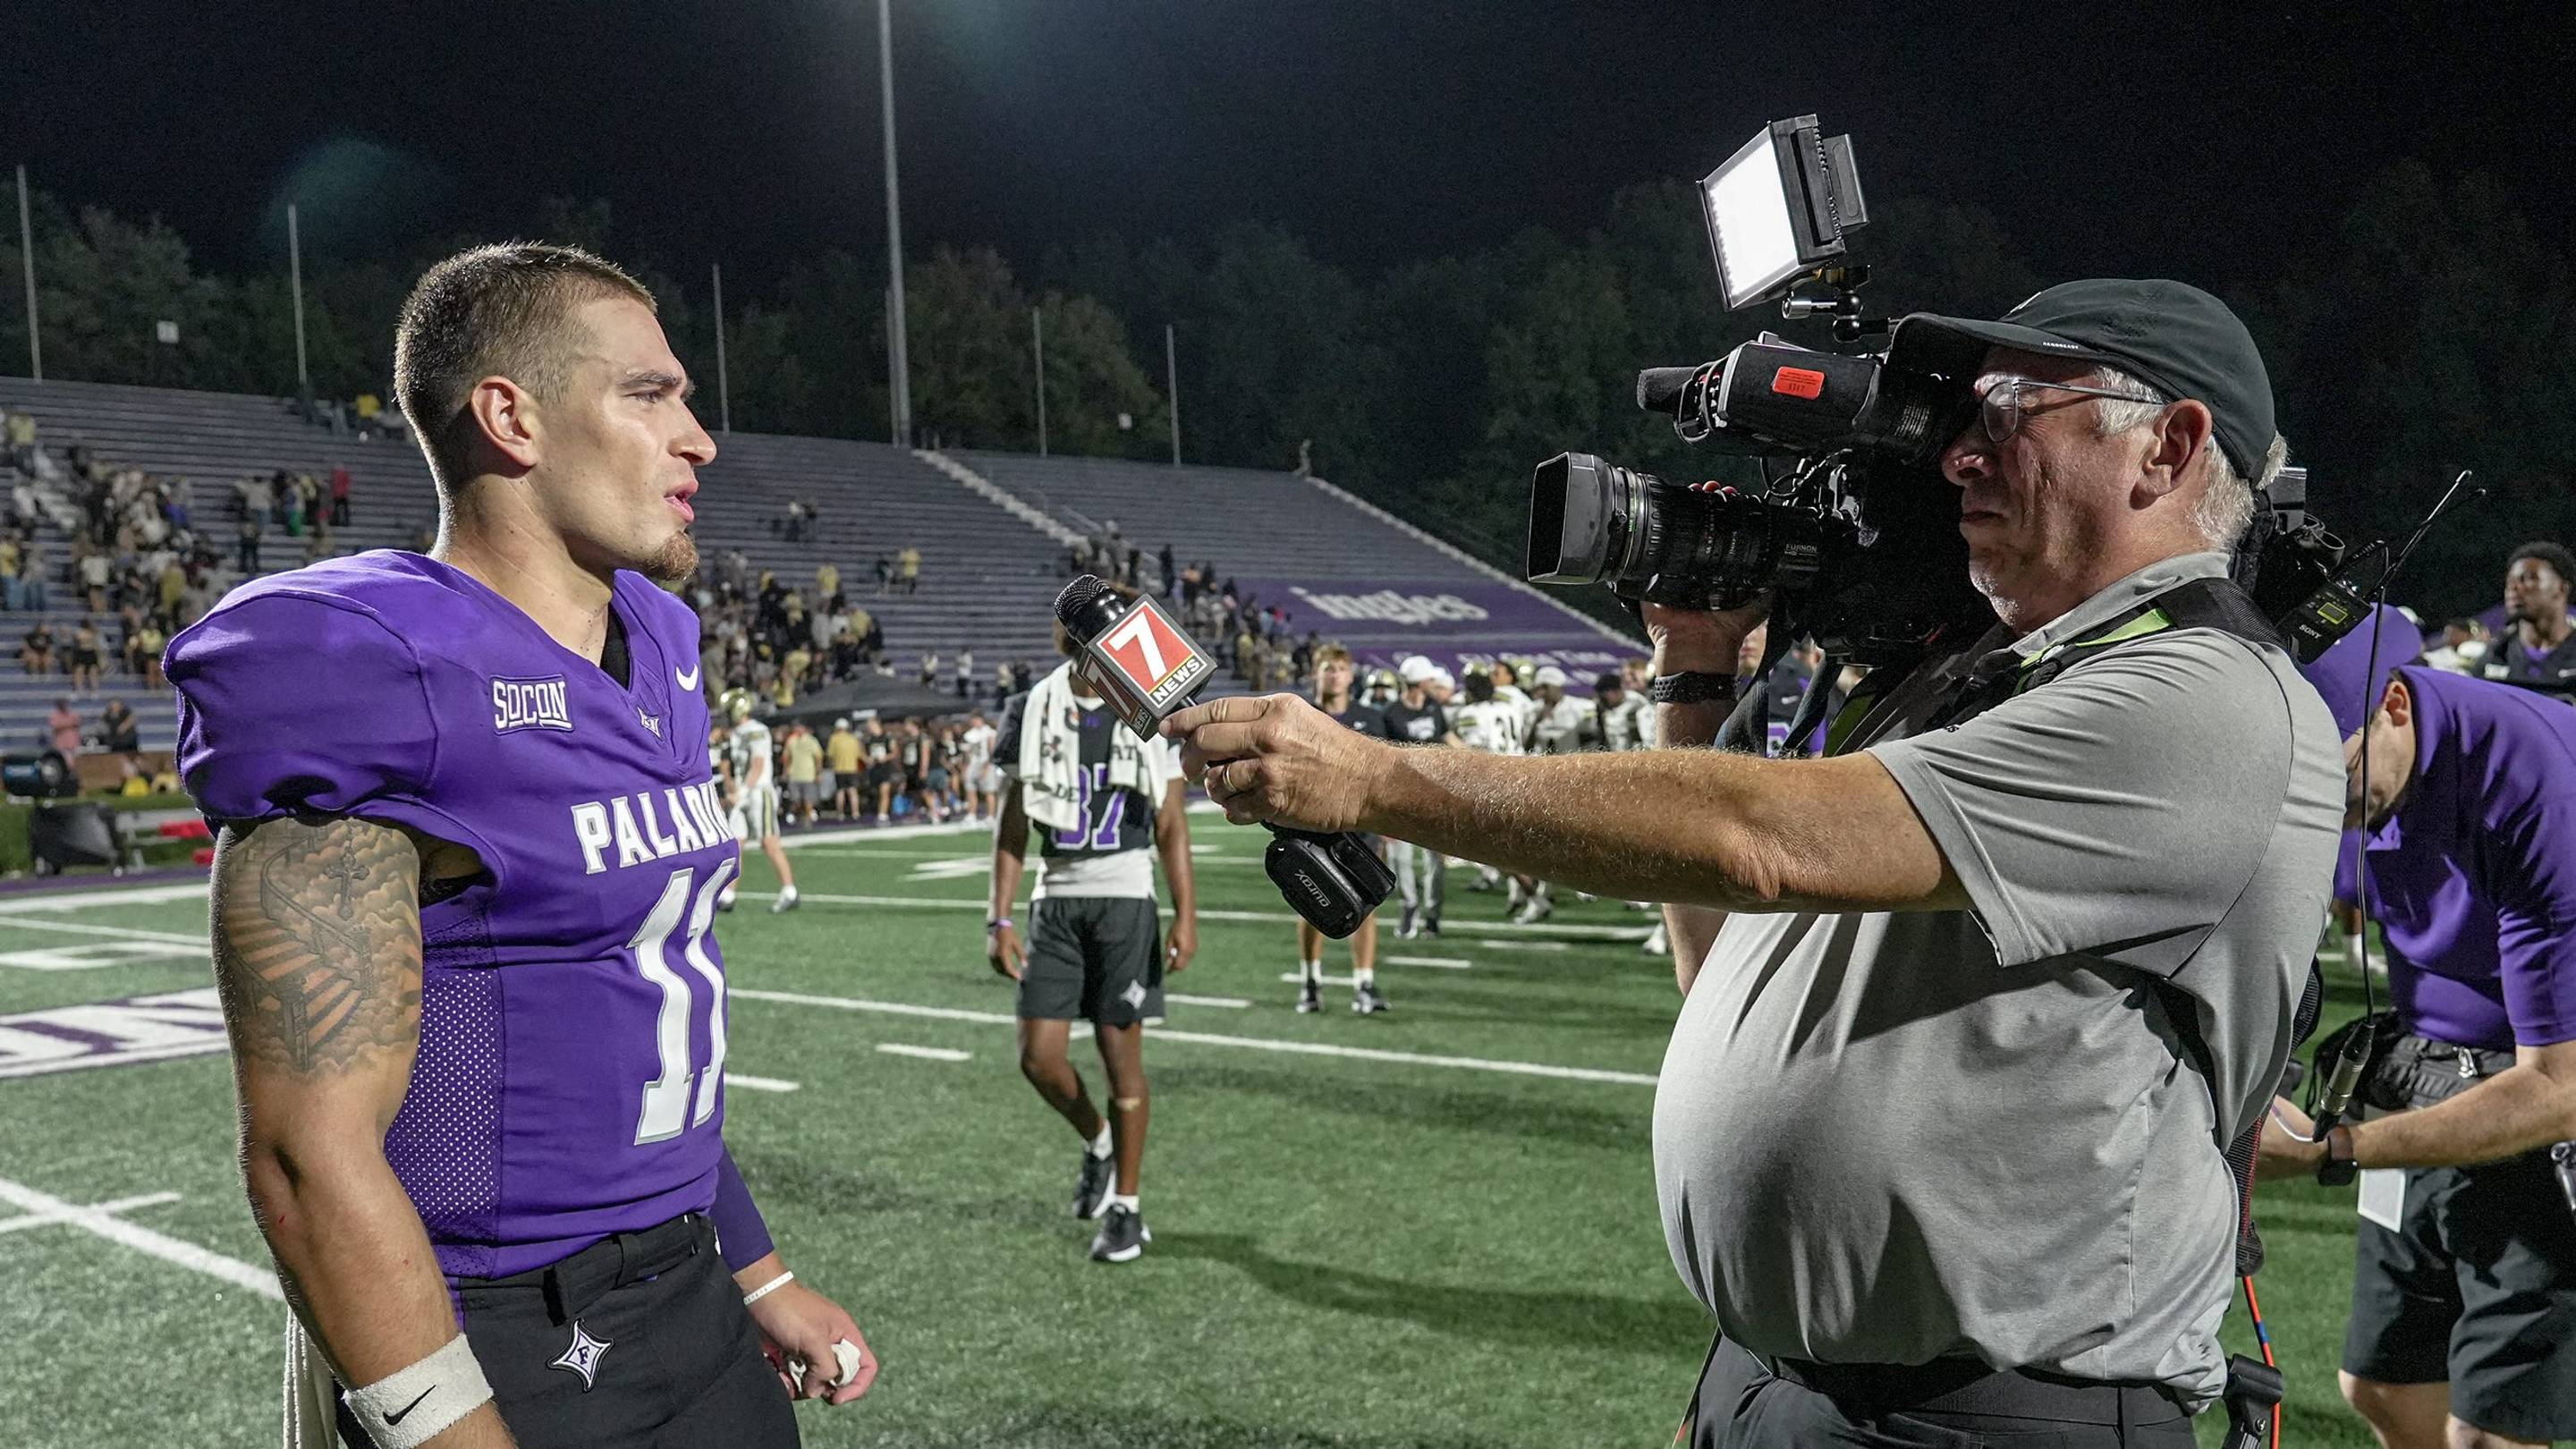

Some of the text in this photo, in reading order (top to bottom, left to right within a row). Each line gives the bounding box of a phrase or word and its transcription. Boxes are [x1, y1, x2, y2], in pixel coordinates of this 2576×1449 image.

[1108, 612, 1167, 682] 7
[2300, 625, 2322, 639] SONY
[493, 681, 572, 729] SOCON
[1086, 662, 1131, 716] 7
[1152, 657, 1200, 703] NEWS
[626, 857, 737, 1145] 11
